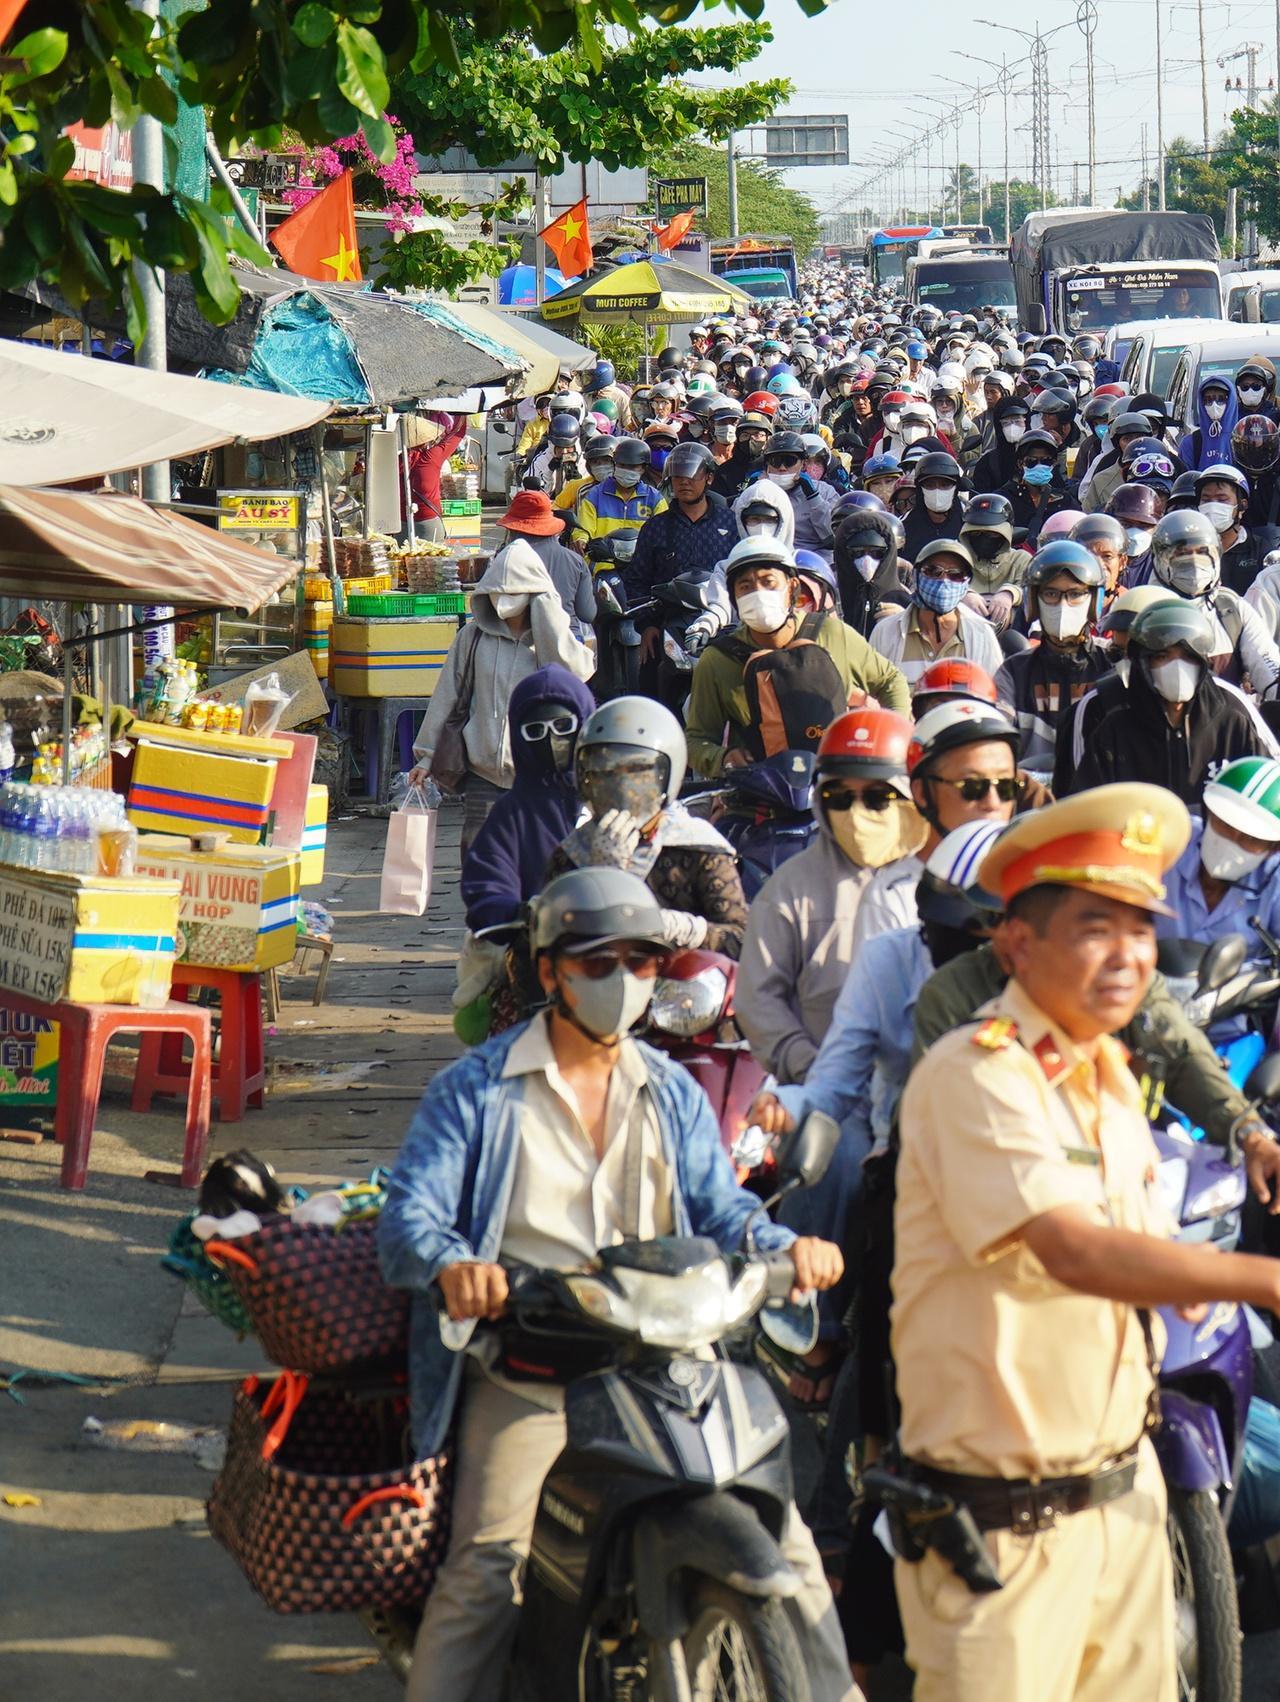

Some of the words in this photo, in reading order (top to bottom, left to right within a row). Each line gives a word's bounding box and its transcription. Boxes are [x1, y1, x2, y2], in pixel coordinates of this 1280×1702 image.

[596, 298, 617, 308] MUTI
[618, 297, 648, 308] COFFEE
[207, 873, 260, 905] VUNG
